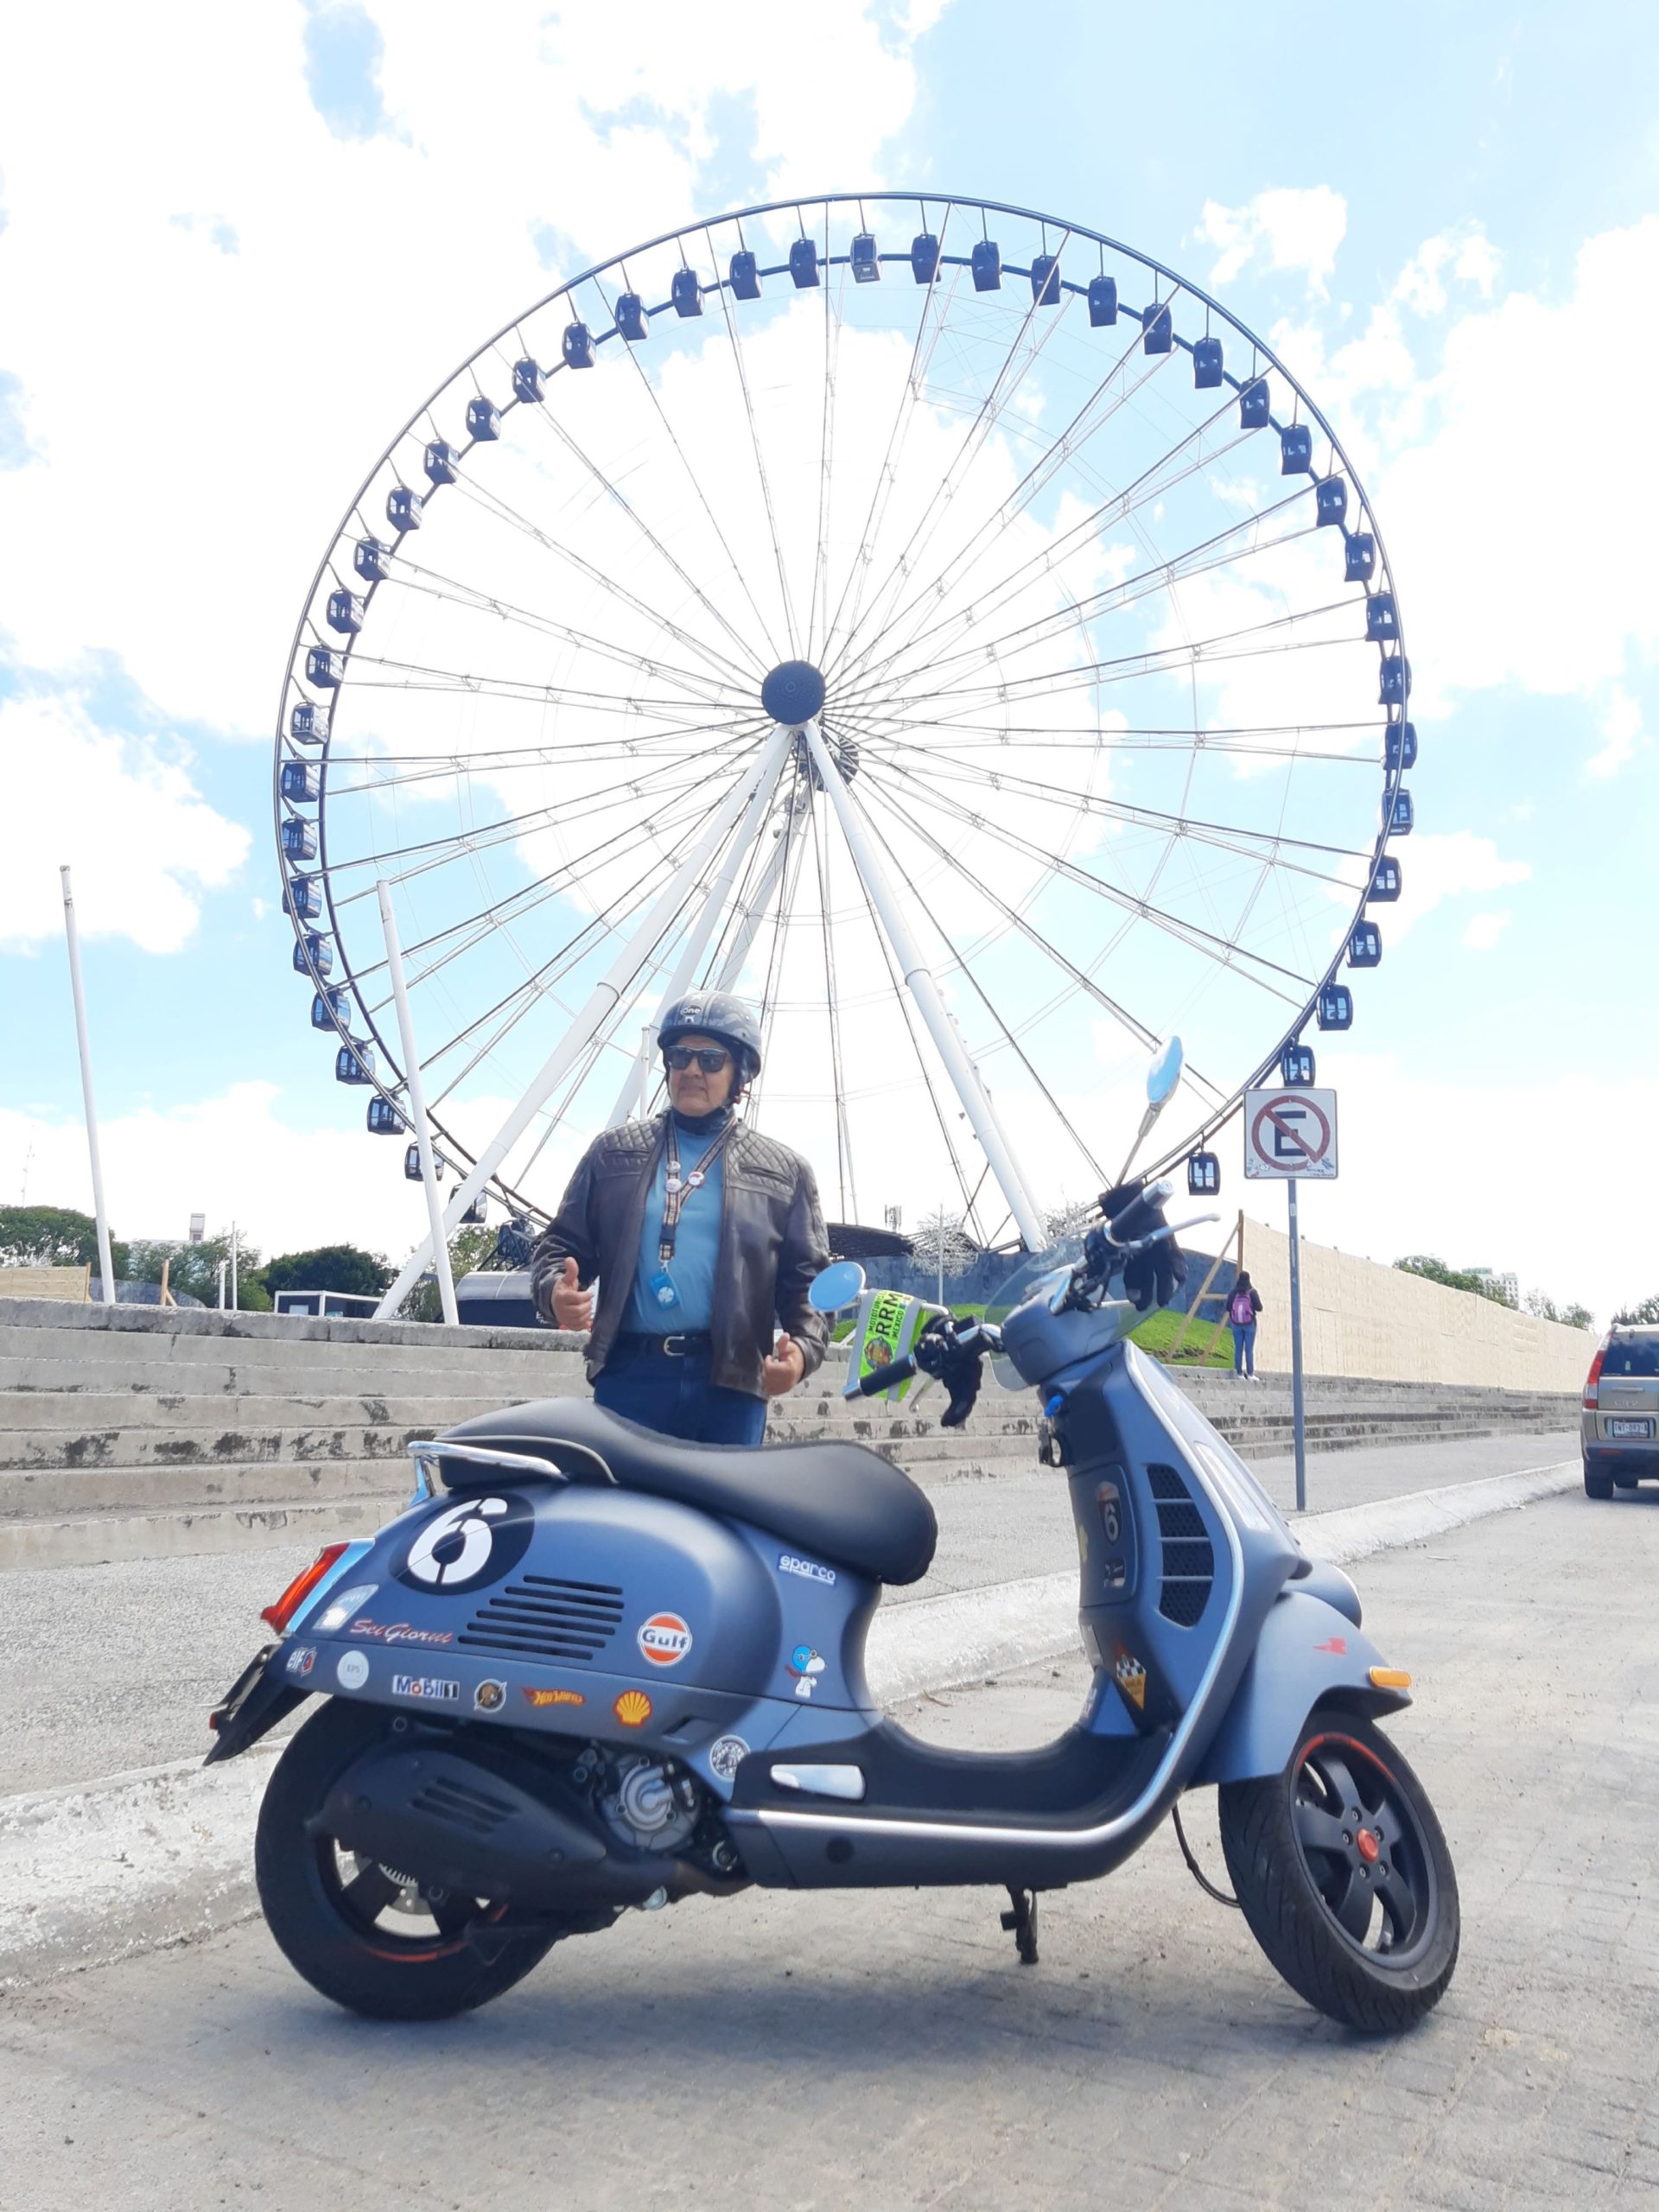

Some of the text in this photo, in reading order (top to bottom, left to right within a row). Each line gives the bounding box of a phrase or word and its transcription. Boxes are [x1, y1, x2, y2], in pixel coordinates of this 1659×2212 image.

[1274, 1111, 1306, 1156] E
[875, 1293, 904, 1336] RRM
[1104, 1503, 1119, 1541] 6
[408, 1497, 508, 1585] 6
[780, 1554, 836, 1582] sparco
[642, 1629, 688, 1649] Gulf
[287, 1649, 305, 1671] elf
[397, 1677, 443, 1697] Mobil
